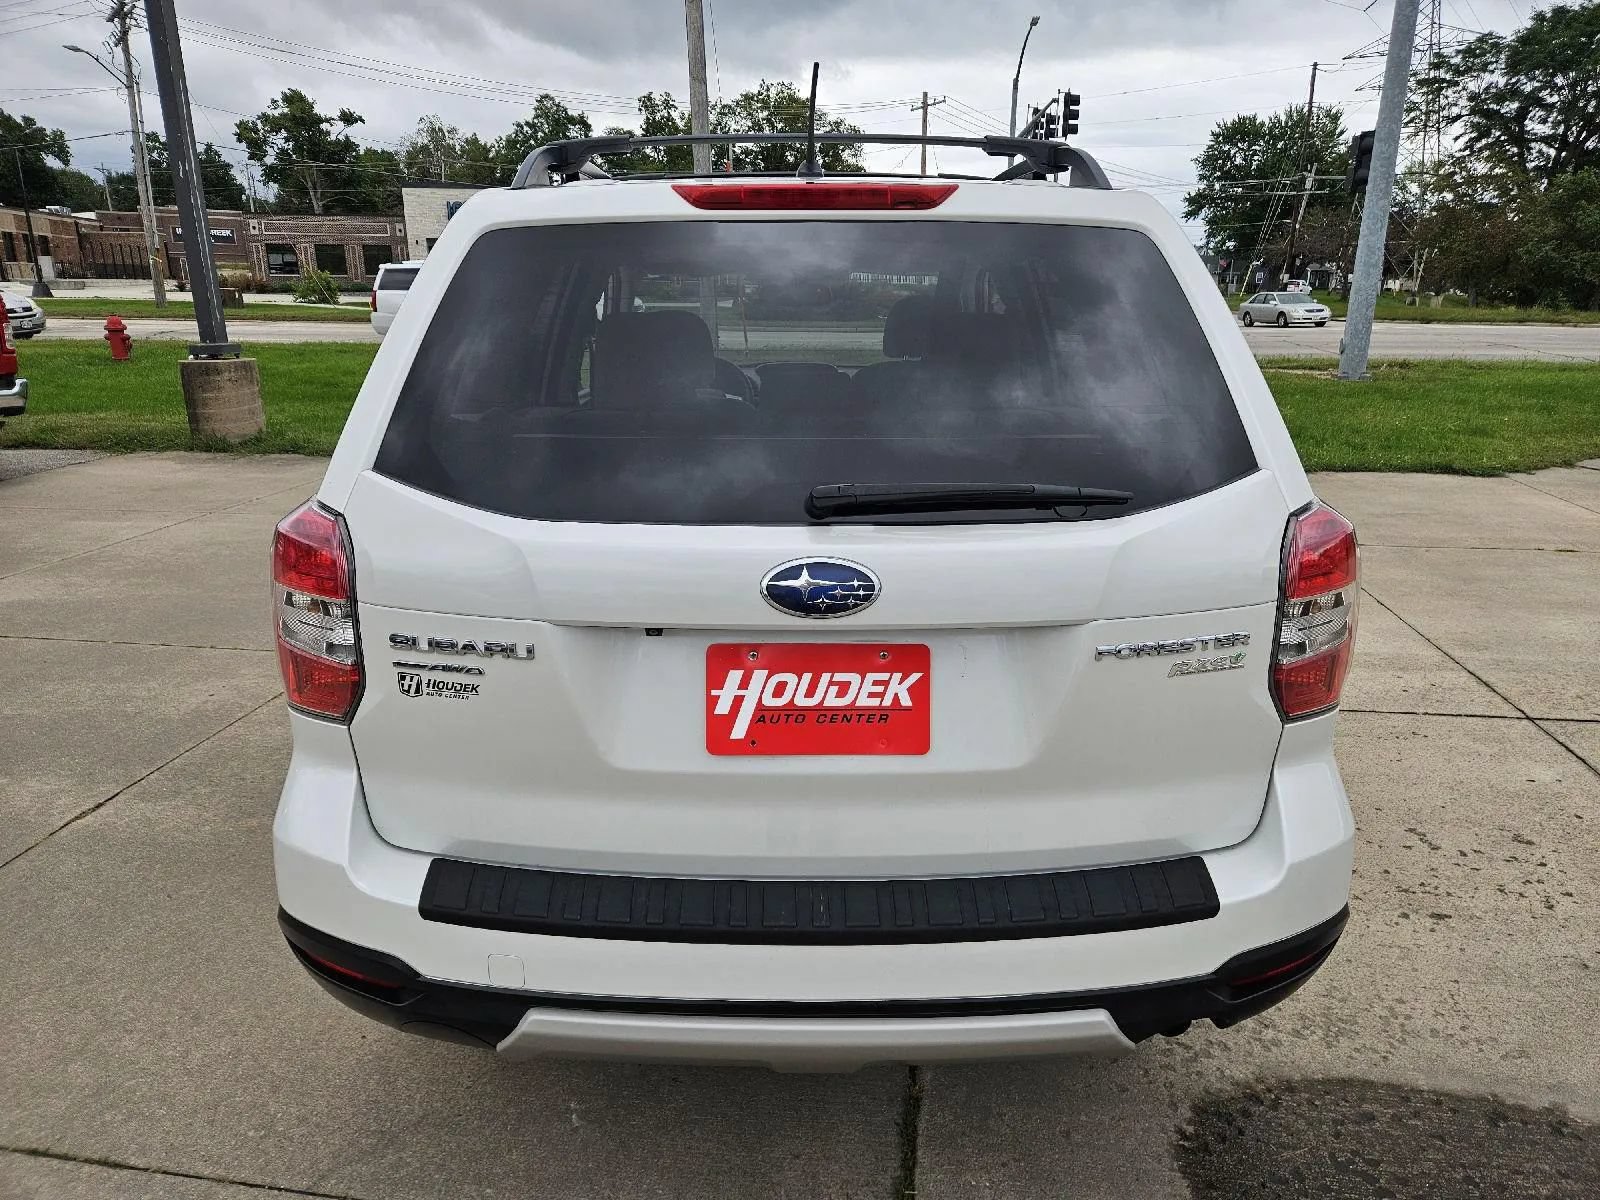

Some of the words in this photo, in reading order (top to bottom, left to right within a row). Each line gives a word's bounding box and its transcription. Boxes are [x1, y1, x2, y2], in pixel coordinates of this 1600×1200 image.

[209, 229, 233, 237] REEK
[388, 632, 535, 660] SUBARU
[1094, 630, 1251, 662] FORESTER
[424, 678, 481, 693] HOUDEK
[444, 693, 470, 701] CENTER
[711, 669, 925, 740] HOUDEK
[755, 713, 806, 724] AUTO
[816, 713, 890, 724] CENTER
